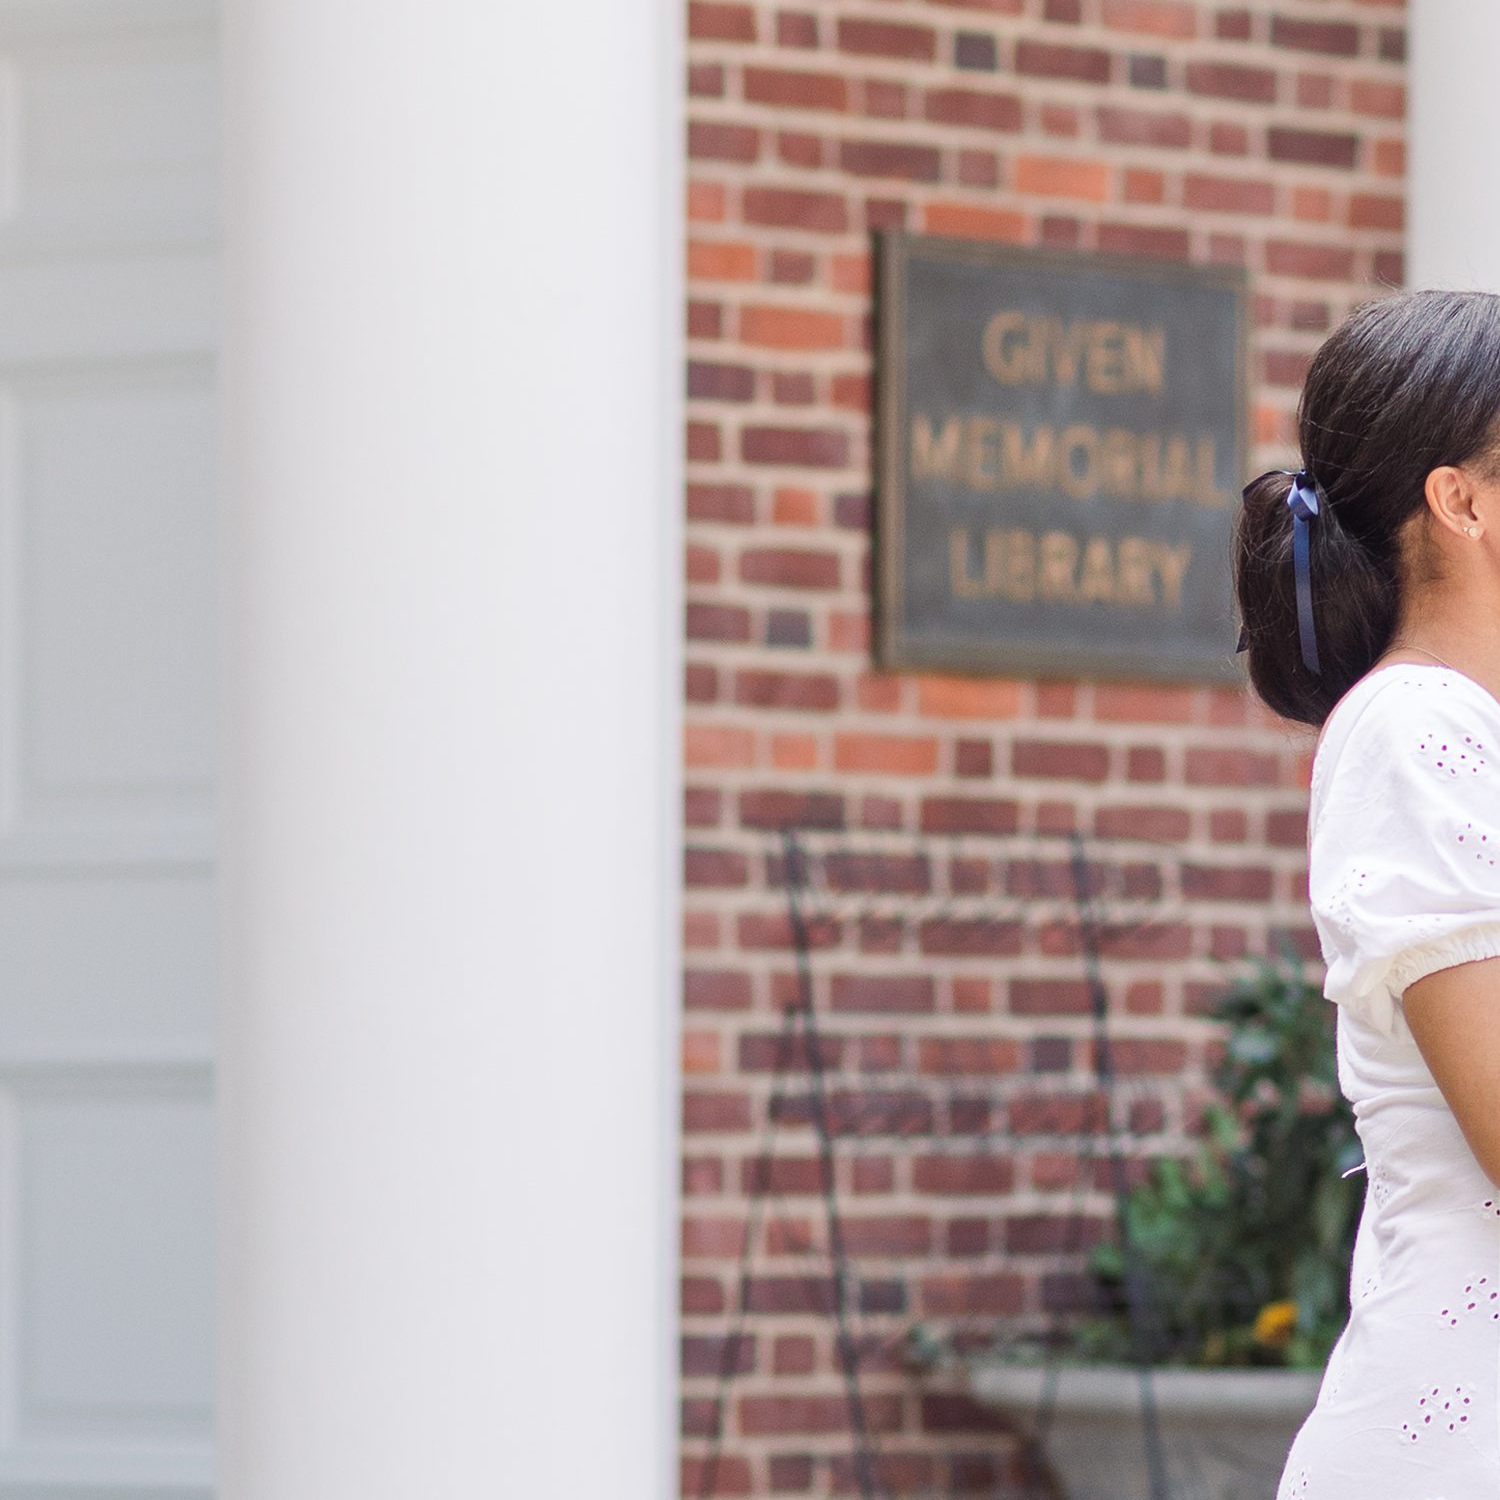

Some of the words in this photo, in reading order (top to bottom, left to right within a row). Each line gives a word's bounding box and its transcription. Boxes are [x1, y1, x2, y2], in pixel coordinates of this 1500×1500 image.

[983, 310, 1166, 397] GIVEN
[910, 413, 1232, 508] MEMORIAL
[950, 526, 1192, 610] LIBRARY
